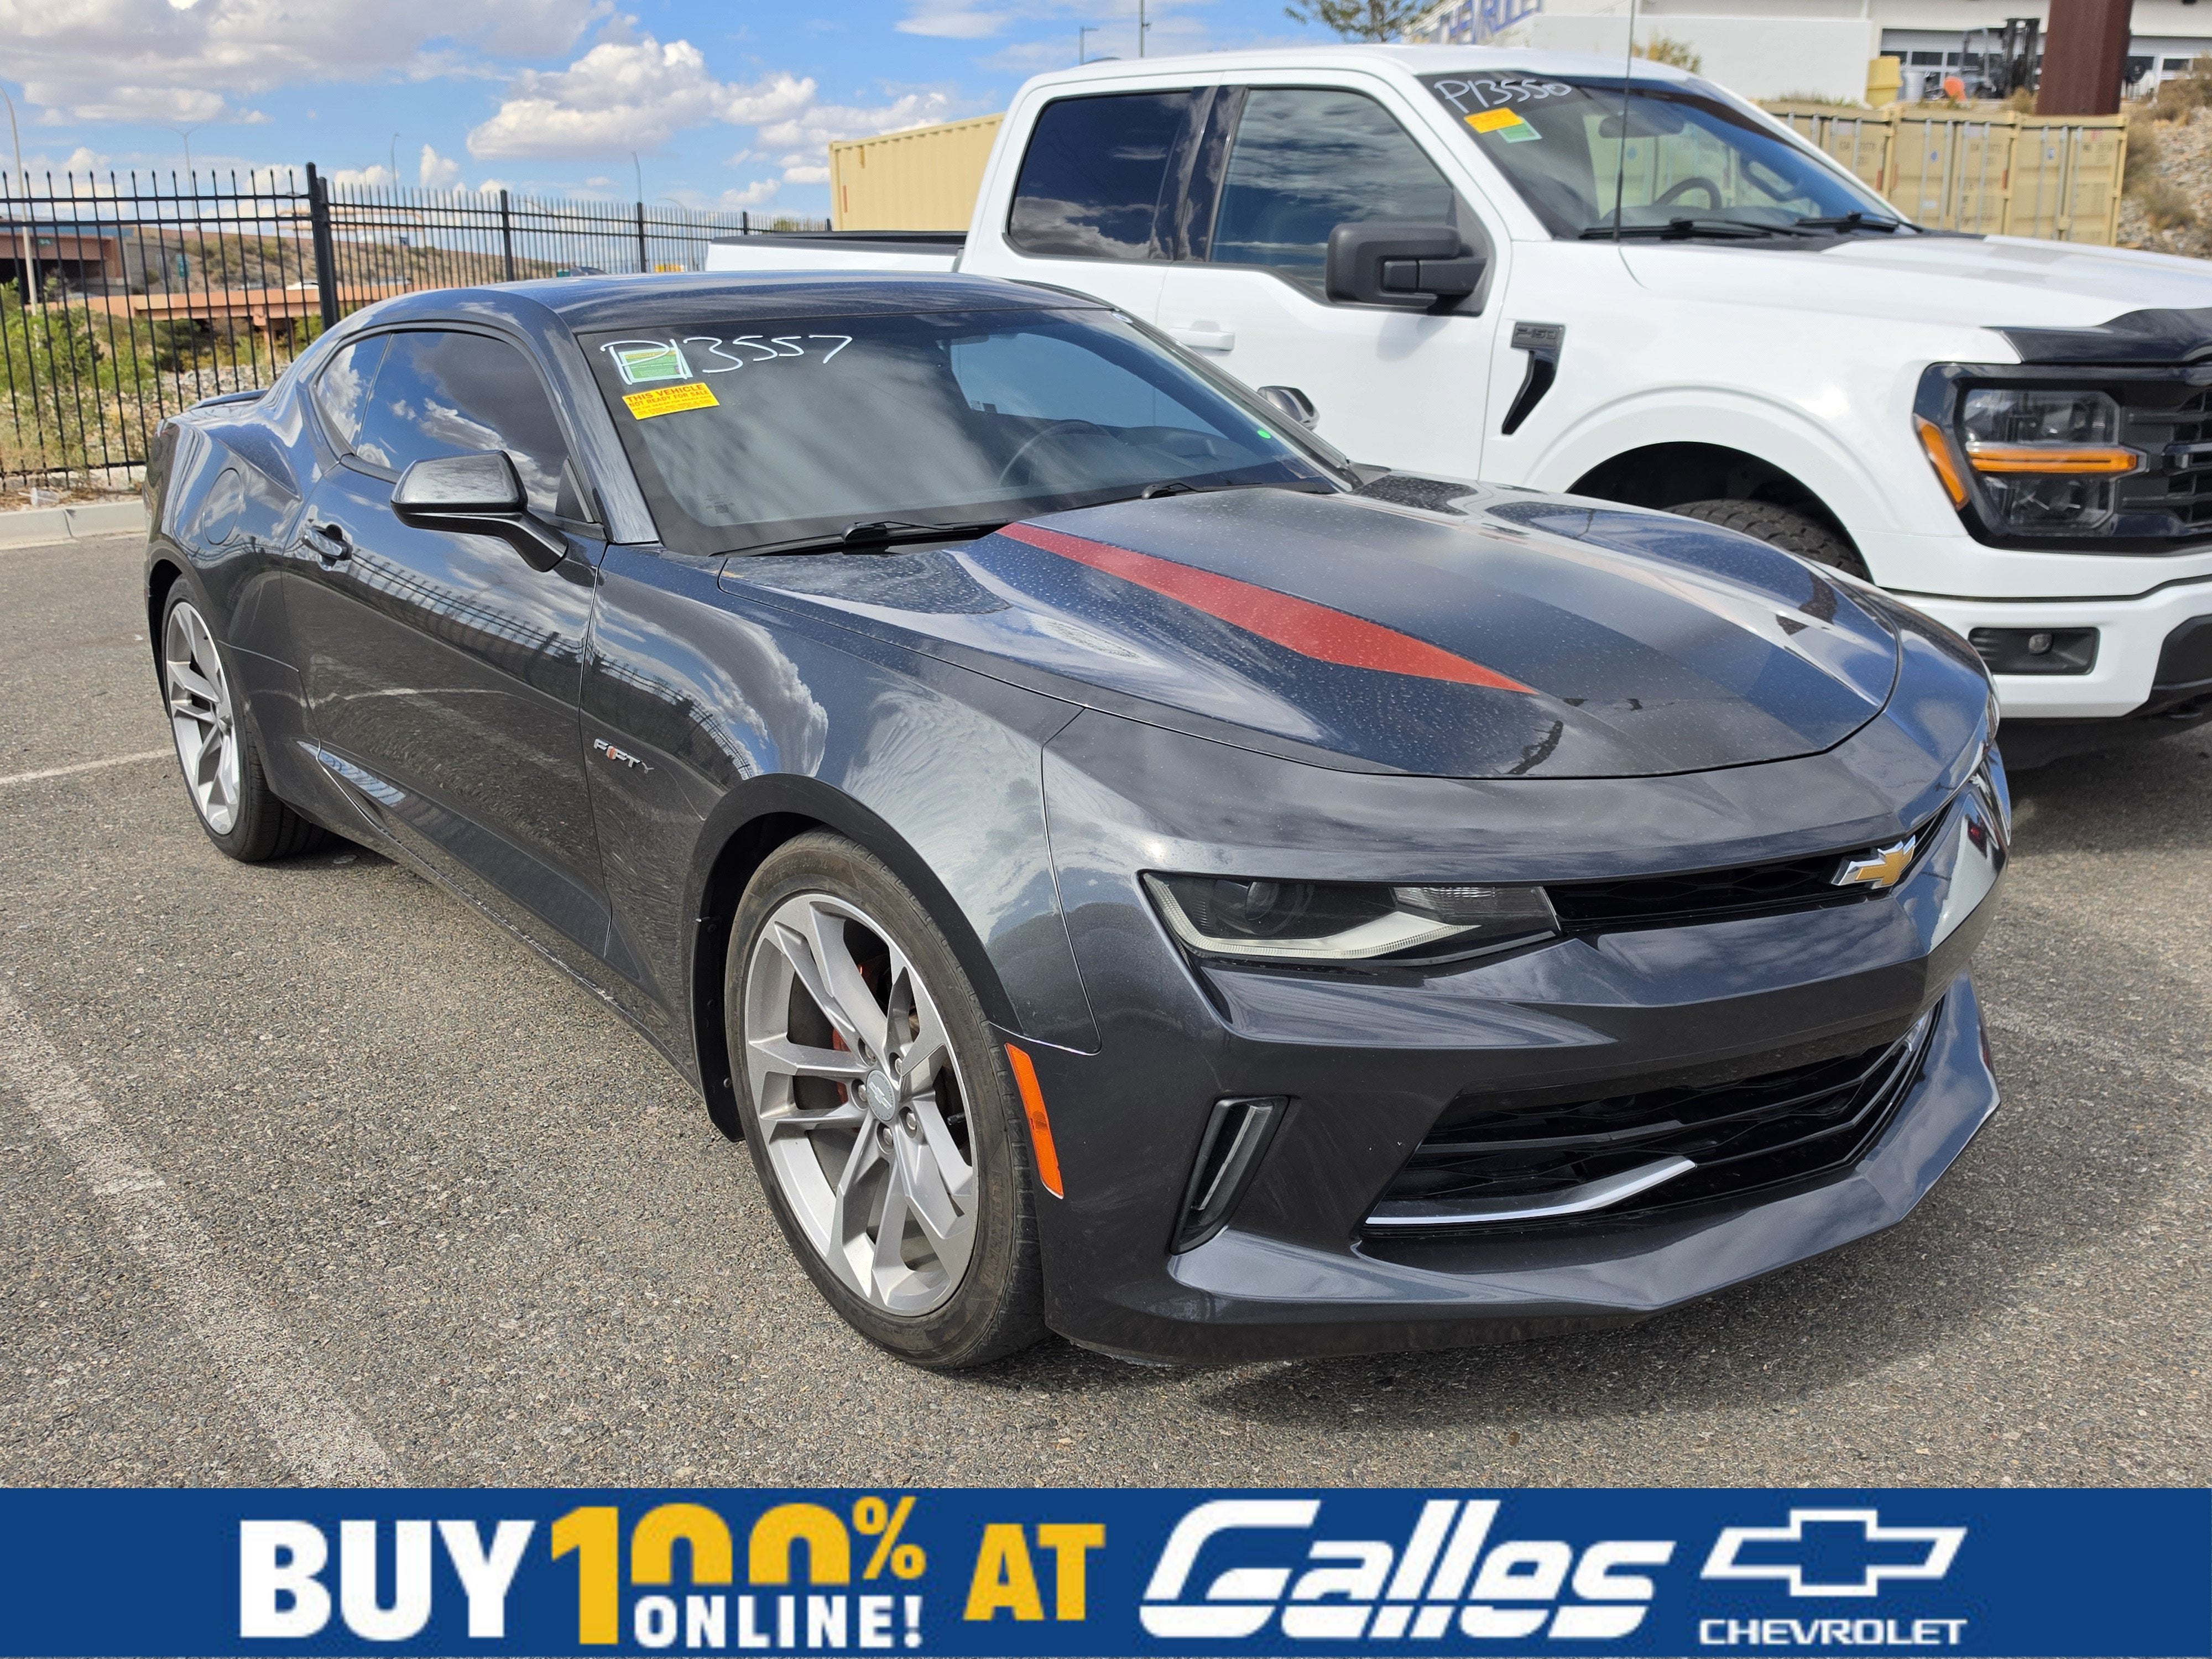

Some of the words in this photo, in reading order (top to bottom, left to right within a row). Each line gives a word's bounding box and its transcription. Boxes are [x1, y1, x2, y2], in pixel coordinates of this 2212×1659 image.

[1434, 79, 1572, 113] P13550
[601, 335, 852, 385] P13557
[626, 392, 653, 403] THIS
[656, 384, 705, 397] VEHICLE
[646, 395, 671, 404] READY
[593, 738, 655, 774] FIFTY
